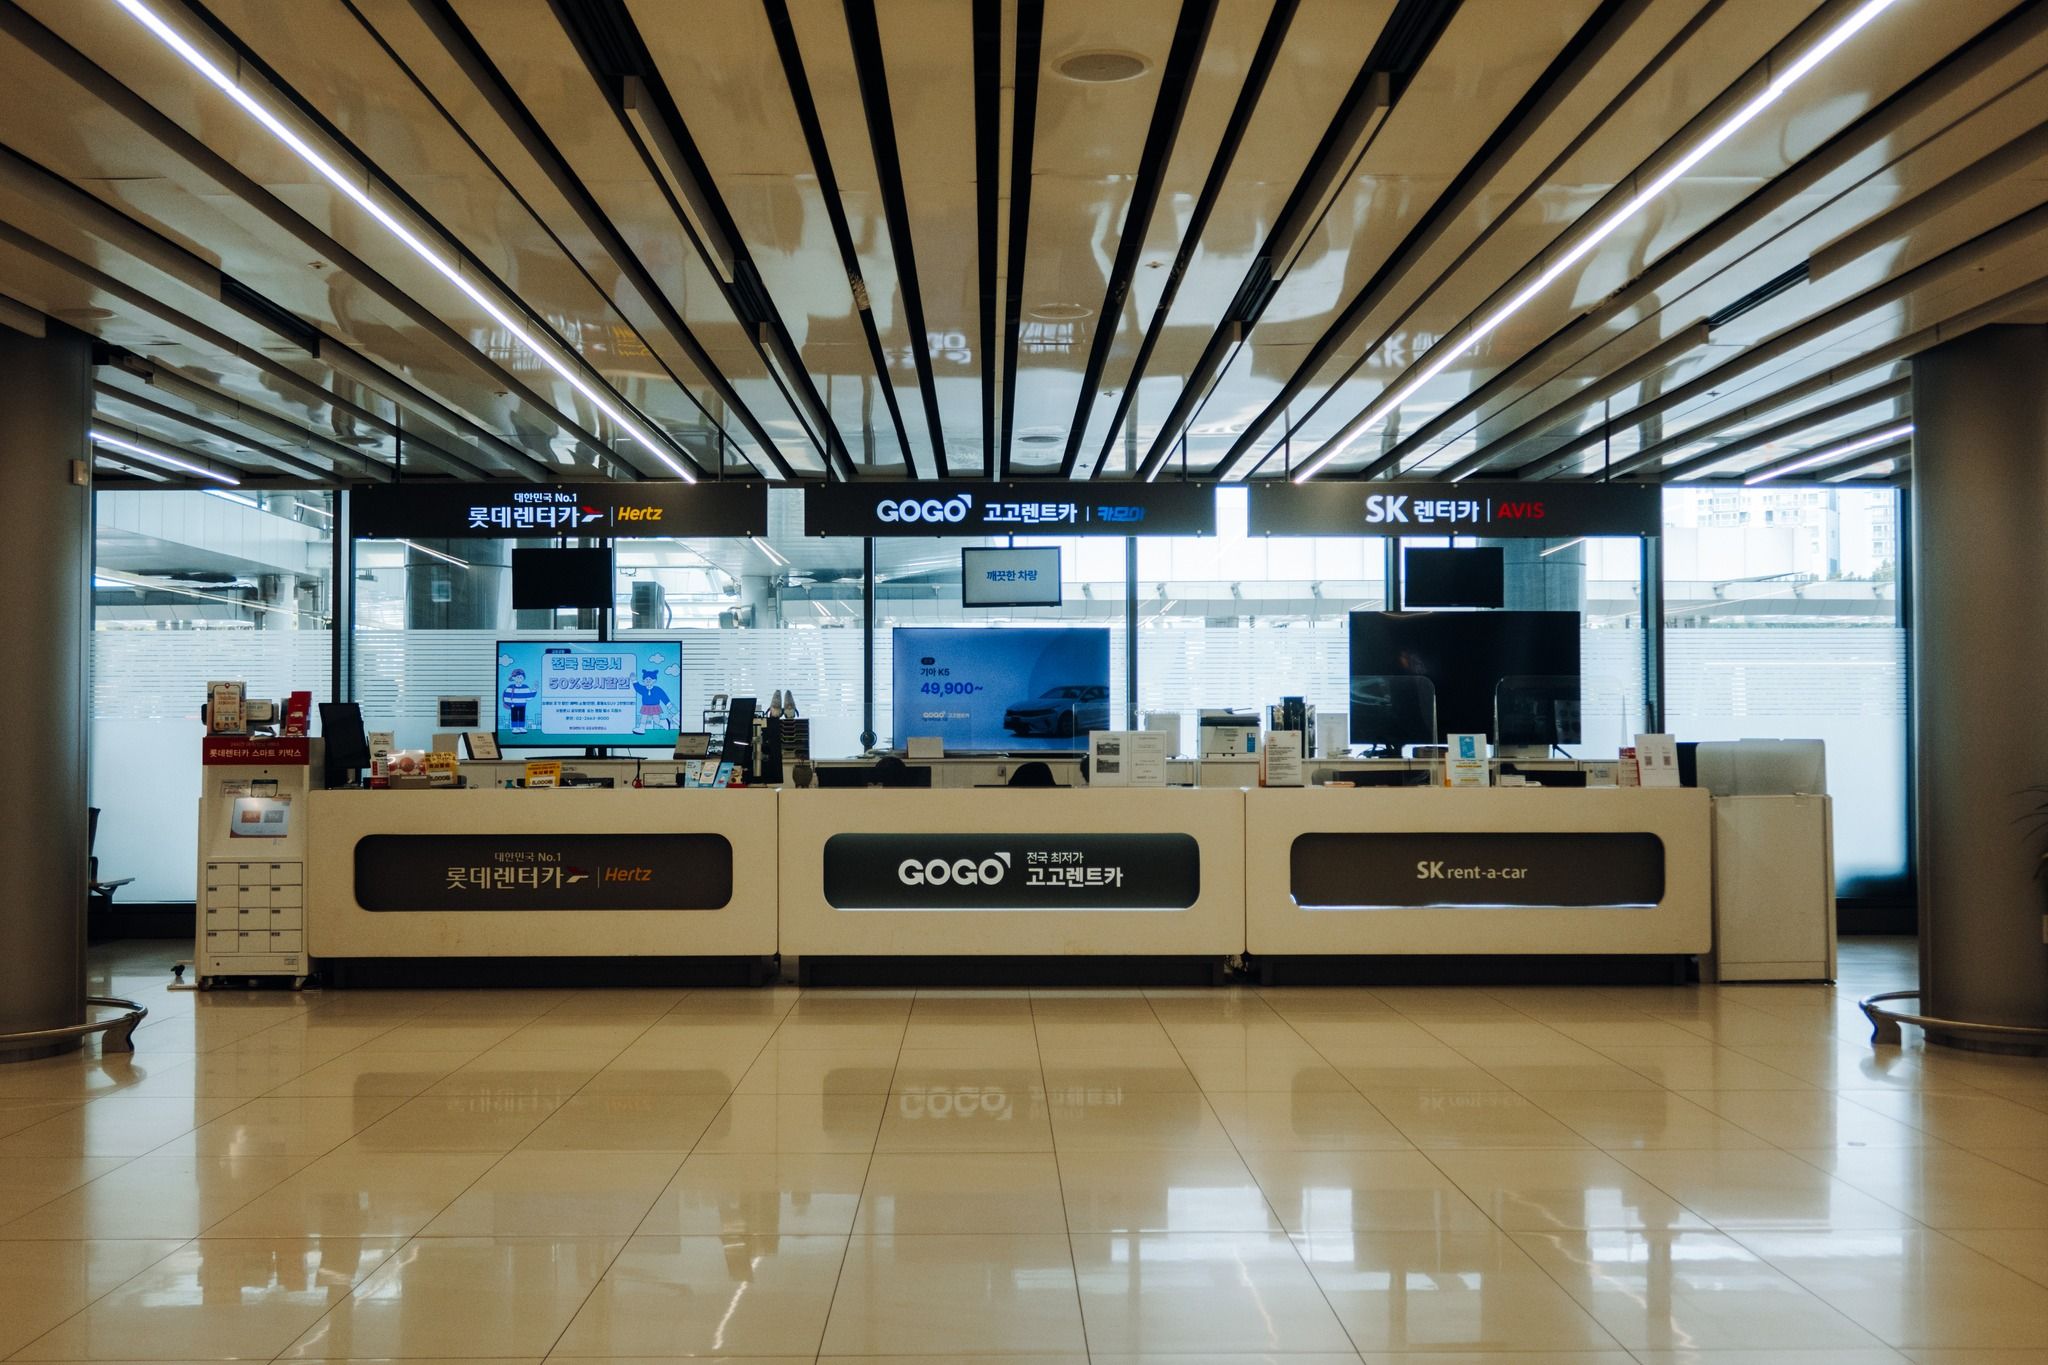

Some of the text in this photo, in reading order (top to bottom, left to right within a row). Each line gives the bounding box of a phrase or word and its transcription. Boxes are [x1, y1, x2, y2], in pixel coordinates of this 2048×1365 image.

[514, 493, 577, 503] 대한민국 No.1
[877, 498, 969, 523] GOGO
[983, 503, 1077, 523] 고고렌트카
[1365, 495, 1546, 523] SK 렌터카 AVIS
[468, 506, 663, 529] 롯데렌터카 Hertz
[986, 569, 1038, 582] 깨끗한 차량
[551, 657, 622, 671] 전국 관공서
[920, 668, 950, 677] 기아 K5
[549, 677, 631, 690] 50%상시할인
[920, 682, 984, 698] 49,900~
[209, 748, 302, 758] 롯데렌터카 스마트 키박스
[494, 852, 561, 862] 대한민국 No.1
[1026, 851, 1084, 864] 전국 최저가
[446, 866, 653, 889] 롯데렌터카 Hertz
[898, 857, 1007, 886] GOGO
[1026, 866, 1124, 888] 고고렌트카
[1417, 861, 1528, 879] SK rent-a-car
